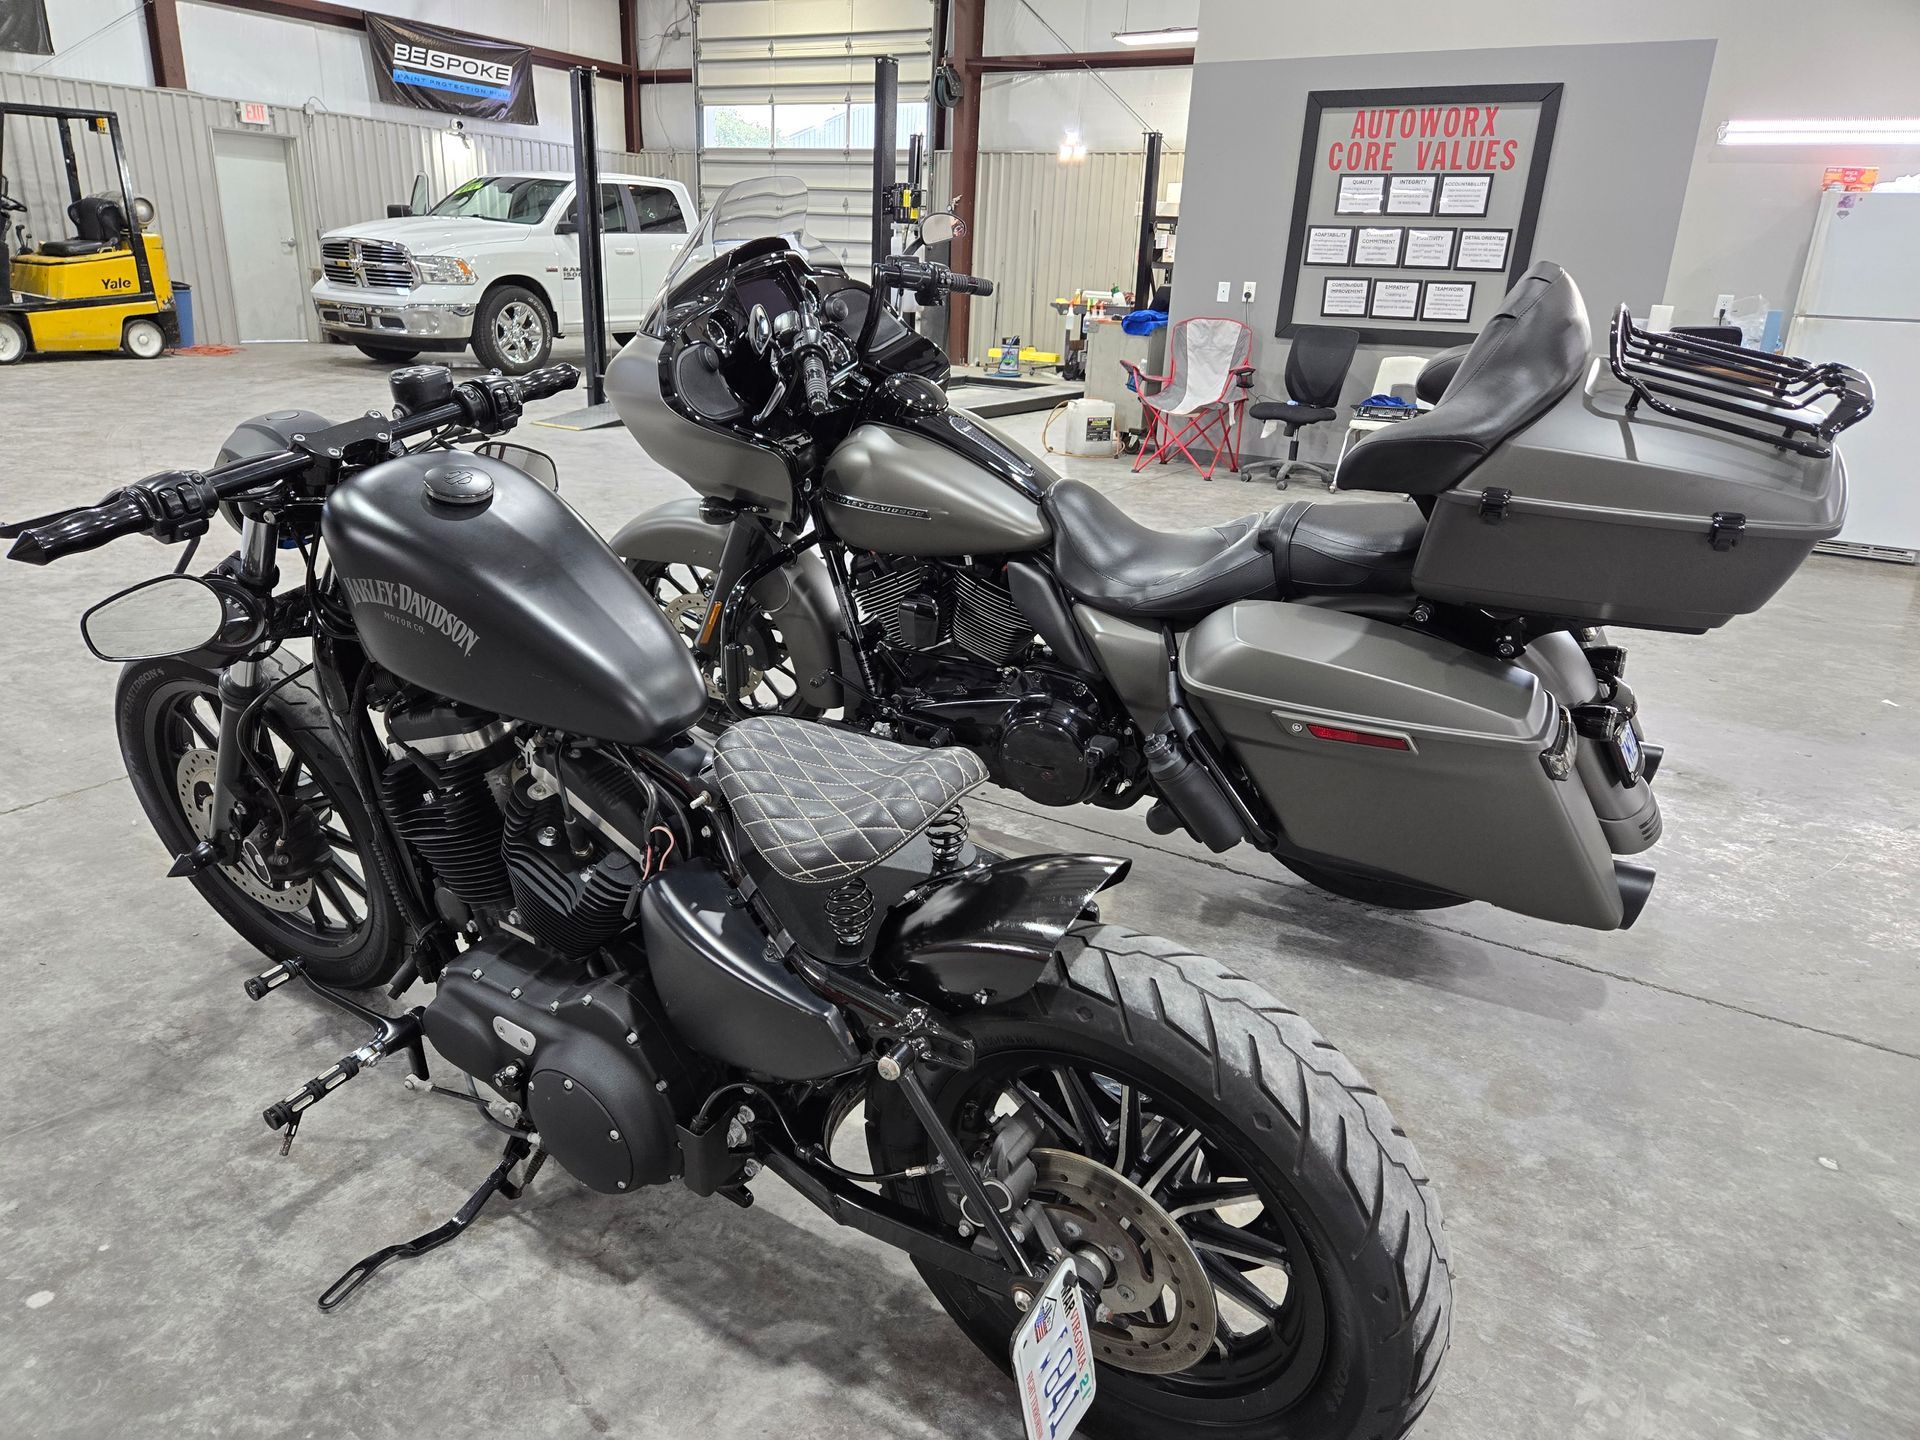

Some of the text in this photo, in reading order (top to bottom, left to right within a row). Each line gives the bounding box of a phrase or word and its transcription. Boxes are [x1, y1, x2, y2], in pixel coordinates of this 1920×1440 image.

[394, 43, 510, 82] BESPOKE
[396, 72, 427, 83] PAINT
[429, 79, 487, 94] PROTECTION
[245, 103, 265, 121] EXIT
[1350, 105, 1500, 139] AUTOWORX
[1328, 139, 1518, 171] CORE VALUES
[101, 277, 132, 290] Yale
[383, 610, 412, 629] MOTOR
[1070, 1307, 1087, 1373] VIRGINIA
